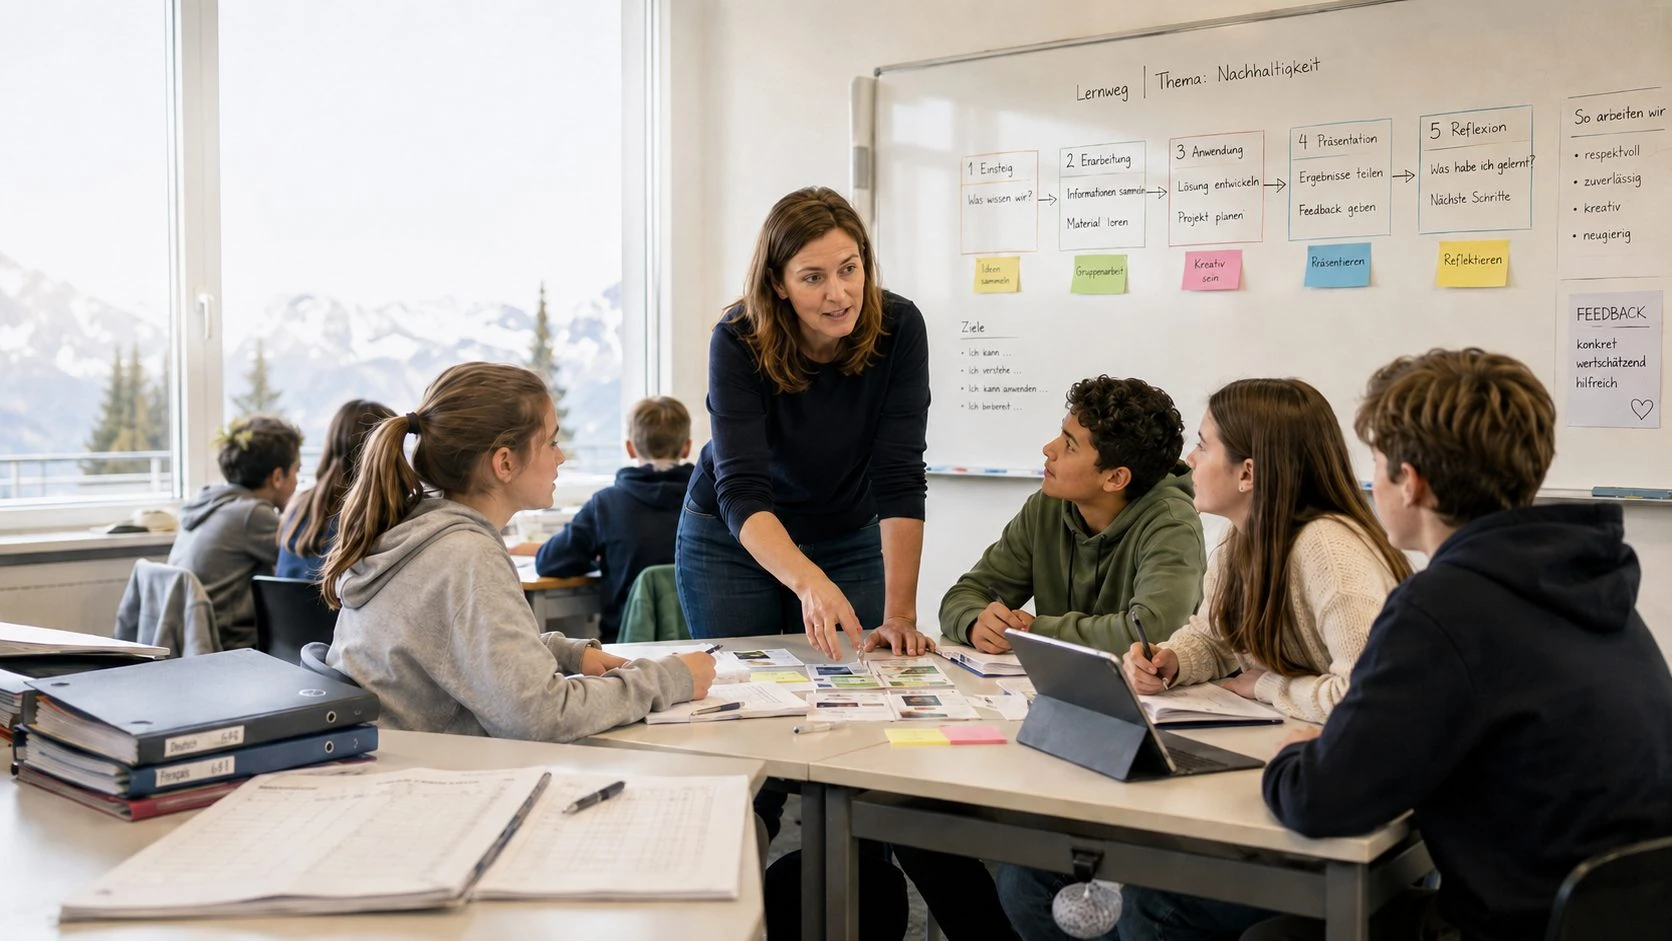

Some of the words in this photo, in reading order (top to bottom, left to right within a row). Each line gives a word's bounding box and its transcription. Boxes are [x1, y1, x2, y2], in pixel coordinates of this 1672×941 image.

[1076, 84, 1129, 102] Lernweg
[1155, 71, 1207, 90] Thema:
[1218, 58, 1321, 83] Nachhaltigkeit
[1574, 108, 1591, 125] So
[1597, 107, 1644, 122] arbeiten
[1648, 105, 1666, 118] wir
[1429, 121, 1442, 140] 5
[1451, 122, 1507, 137] Reflexion
[1298, 133, 1308, 150] 4
[1318, 133, 1378, 148] Präsentation
[1176, 144, 1186, 160] 3
[1192, 145, 1244, 160] Anwendung
[1584, 146, 1641, 162] respektvoll
[968, 162, 974, 175] 1
[1066, 153, 1075, 168] 2
[1081, 153, 1131, 169] Erarbeitung
[1430, 163, 1450, 175] Was
[1454, 160, 1477, 173] habe
[1480, 159, 1494, 171] ich
[1497, 154, 1536, 174] gelernt?
[1178, 180, 1209, 195] Lösung
[1214, 175, 1260, 190] entwickeln
[1299, 169, 1350, 187] Ergebnisse
[1357, 168, 1383, 180] teilen
[1584, 172, 1642, 188] zuverlässig
[1067, 187, 1116, 200] Informationen
[1430, 191, 1467, 206] Nächste
[1472, 190, 1511, 204] Schritte
[1299, 203, 1342, 216] Feedback
[1348, 202, 1376, 217] geben
[1584, 201, 1621, 214] kreativ
[1067, 217, 1101, 230] Material
[1178, 211, 1209, 227] Projekt
[1215, 212, 1244, 226] planen
[1583, 228, 1632, 244] neugierig
[1194, 258, 1226, 269] Kreativ
[1444, 253, 1503, 266] Reflektieren
[1202, 274, 1219, 283] sein
[1576, 305, 1647, 321] FEEDBACK
[961, 320, 985, 333] Ziele
[1576, 338, 1617, 349] konkret
[982, 348, 1000, 356] kann
[1576, 355, 1646, 368] wertschätzend
[983, 385, 1000, 393] kann
[1576, 376, 1618, 388] hilfreich
